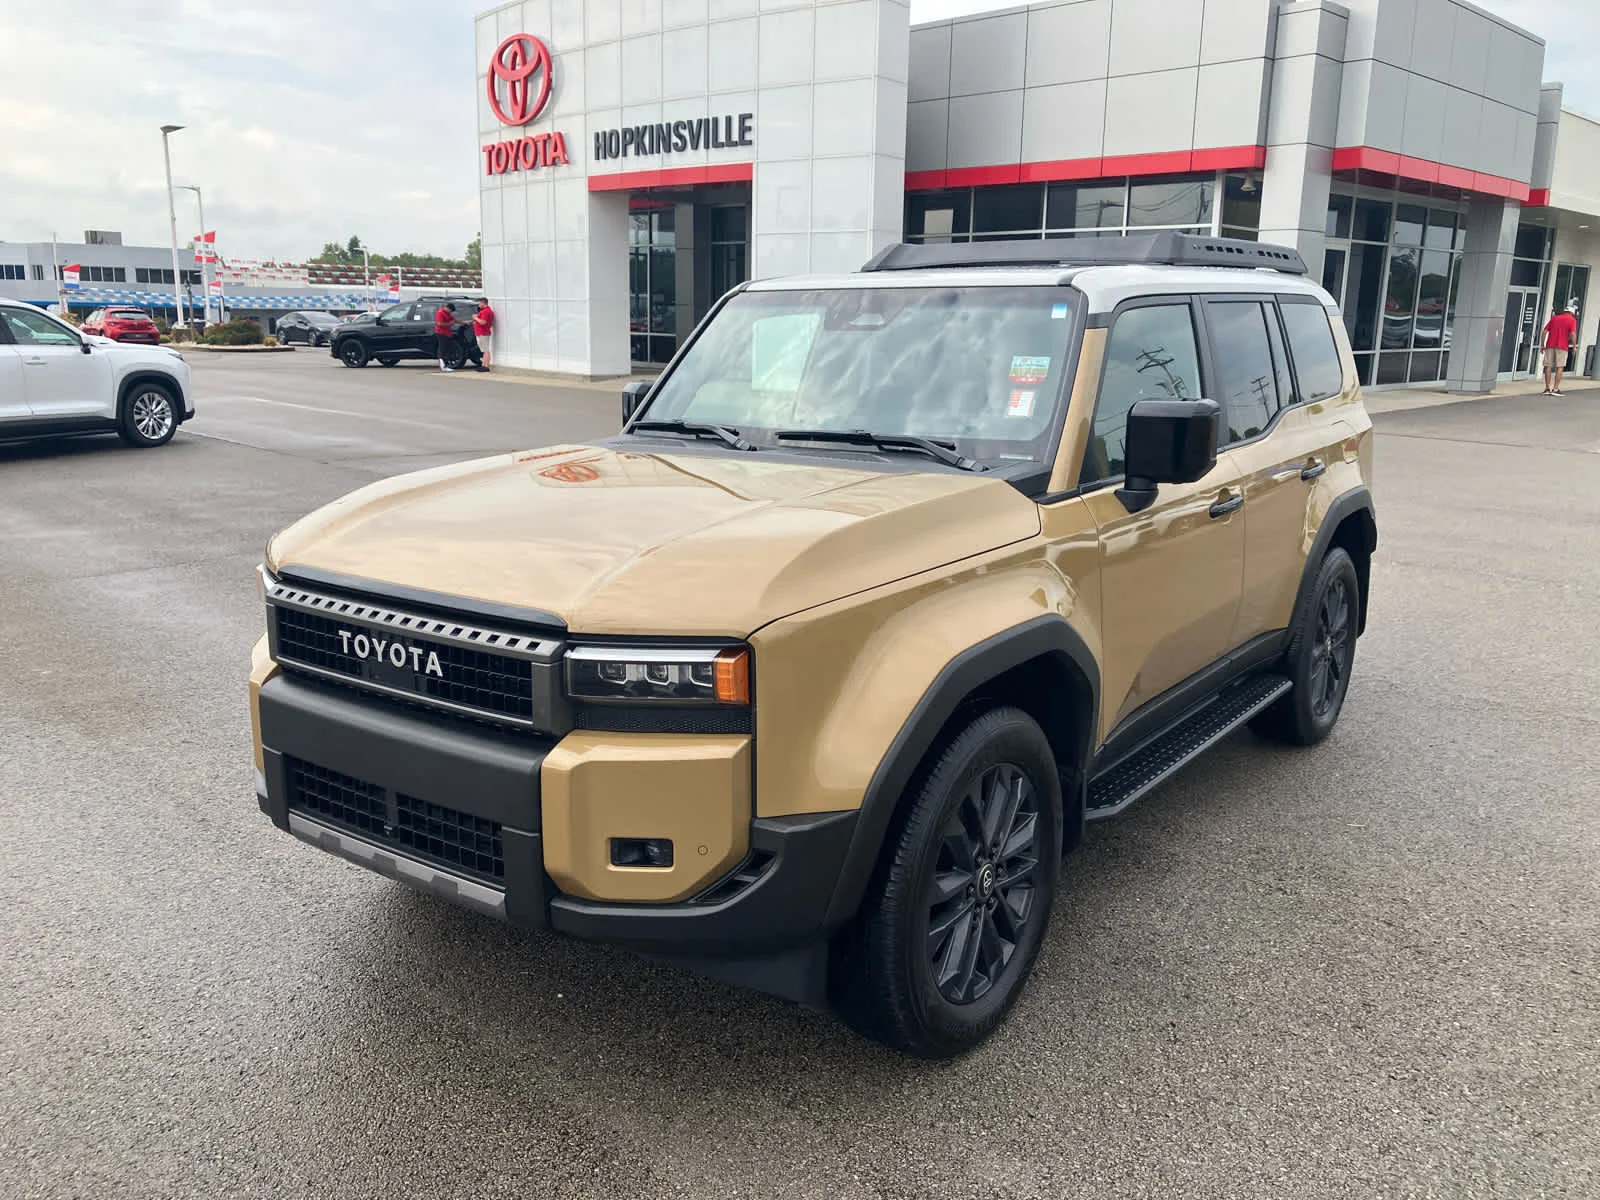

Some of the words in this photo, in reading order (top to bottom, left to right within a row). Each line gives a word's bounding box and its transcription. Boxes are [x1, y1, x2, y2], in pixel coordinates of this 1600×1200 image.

[482, 131, 569, 176] TOYOTA
[594, 113, 753, 160] HOPKINSVILLE
[338, 630, 444, 678] TOYOTA
